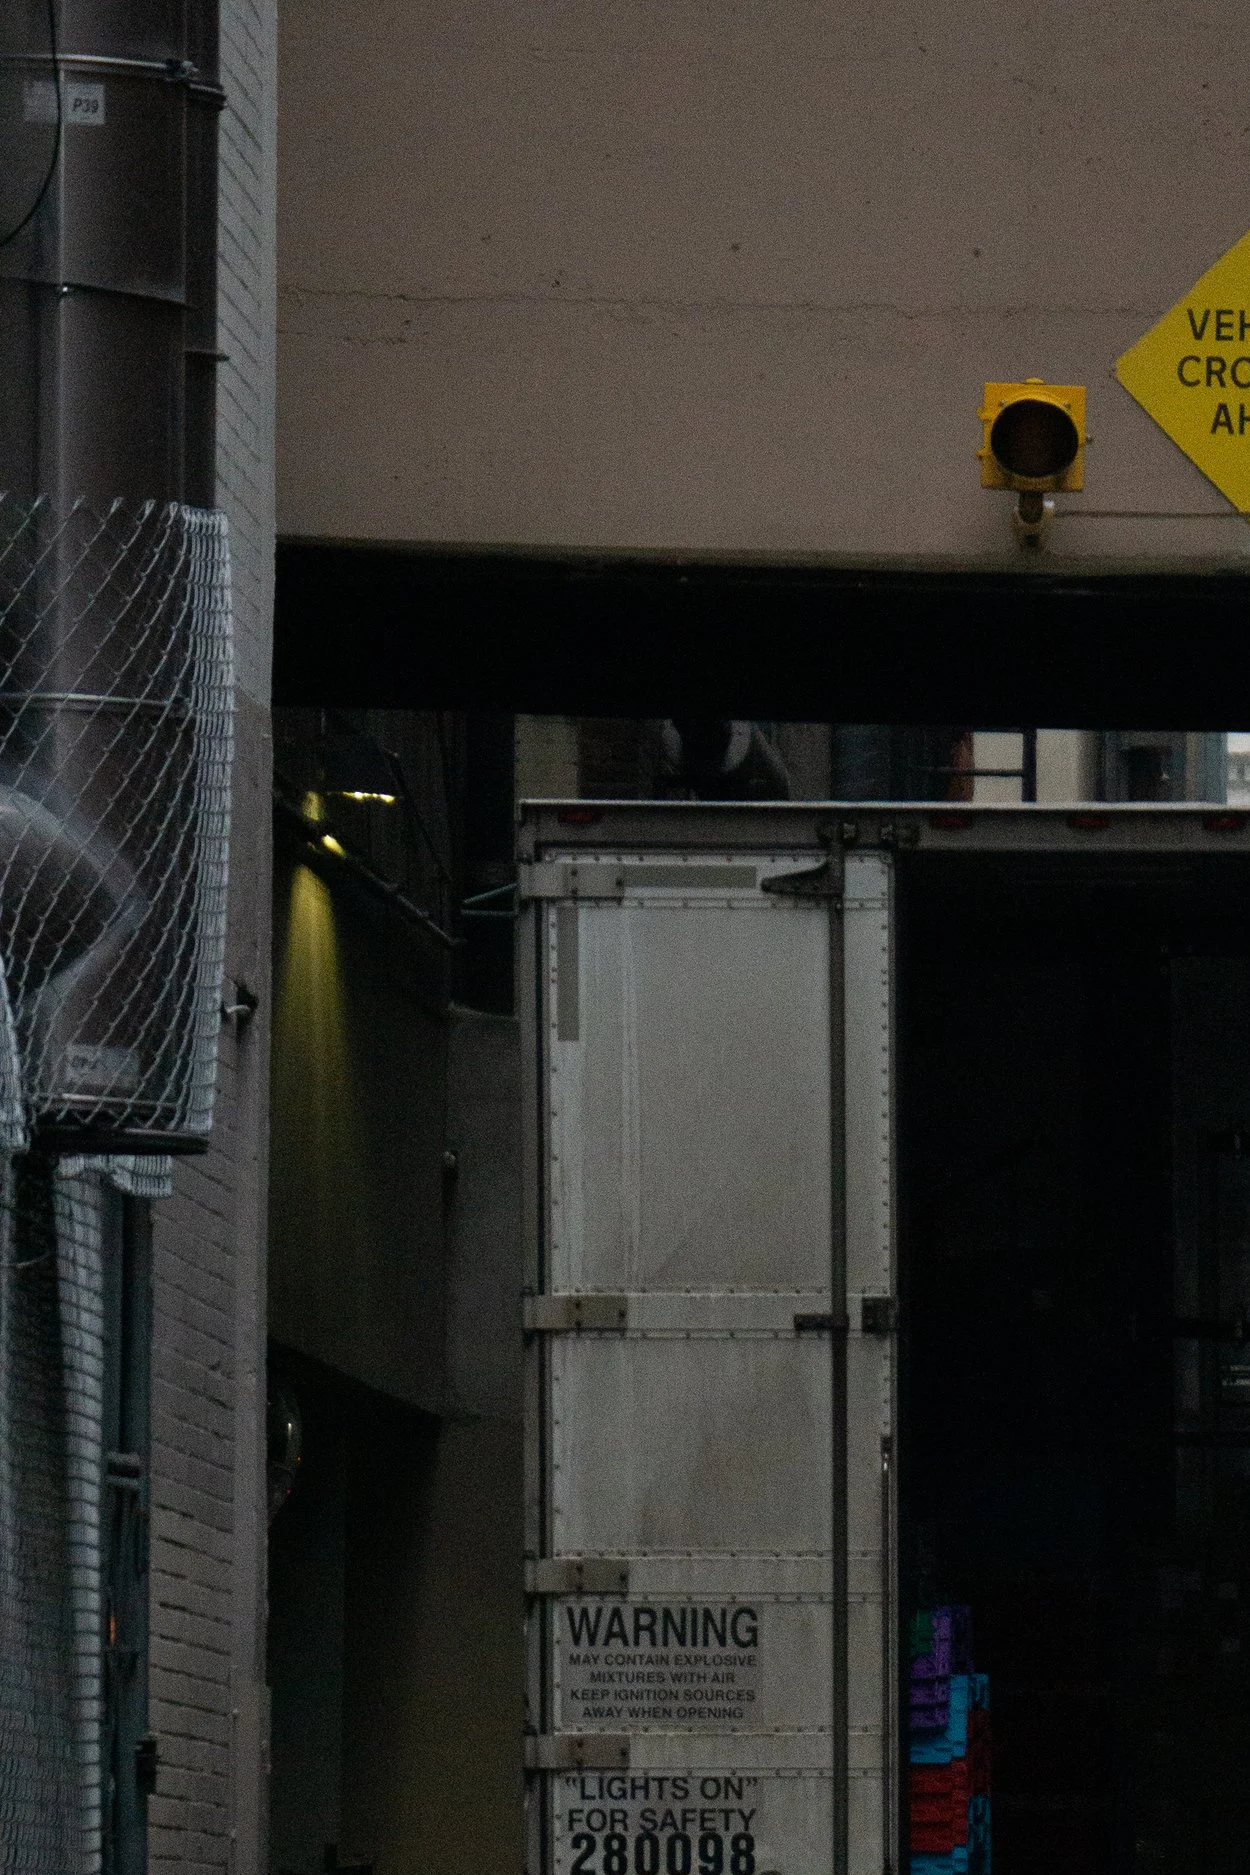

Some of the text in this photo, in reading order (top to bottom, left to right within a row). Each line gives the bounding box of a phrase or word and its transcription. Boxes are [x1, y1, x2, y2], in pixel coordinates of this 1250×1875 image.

[566, 1606, 758, 1648] WARNING
[569, 1654, 757, 1667] MAY CONTAIN EXPLOSIVE
[589, 1671, 736, 1684] MIXTURES WITH AIR
[570, 1689, 755, 1701] KEEP IGNITION SOURCES
[582, 1707, 744, 1719] AWAY WHEN OPENING
[568, 1808, 757, 1832] FOR SAFETY
